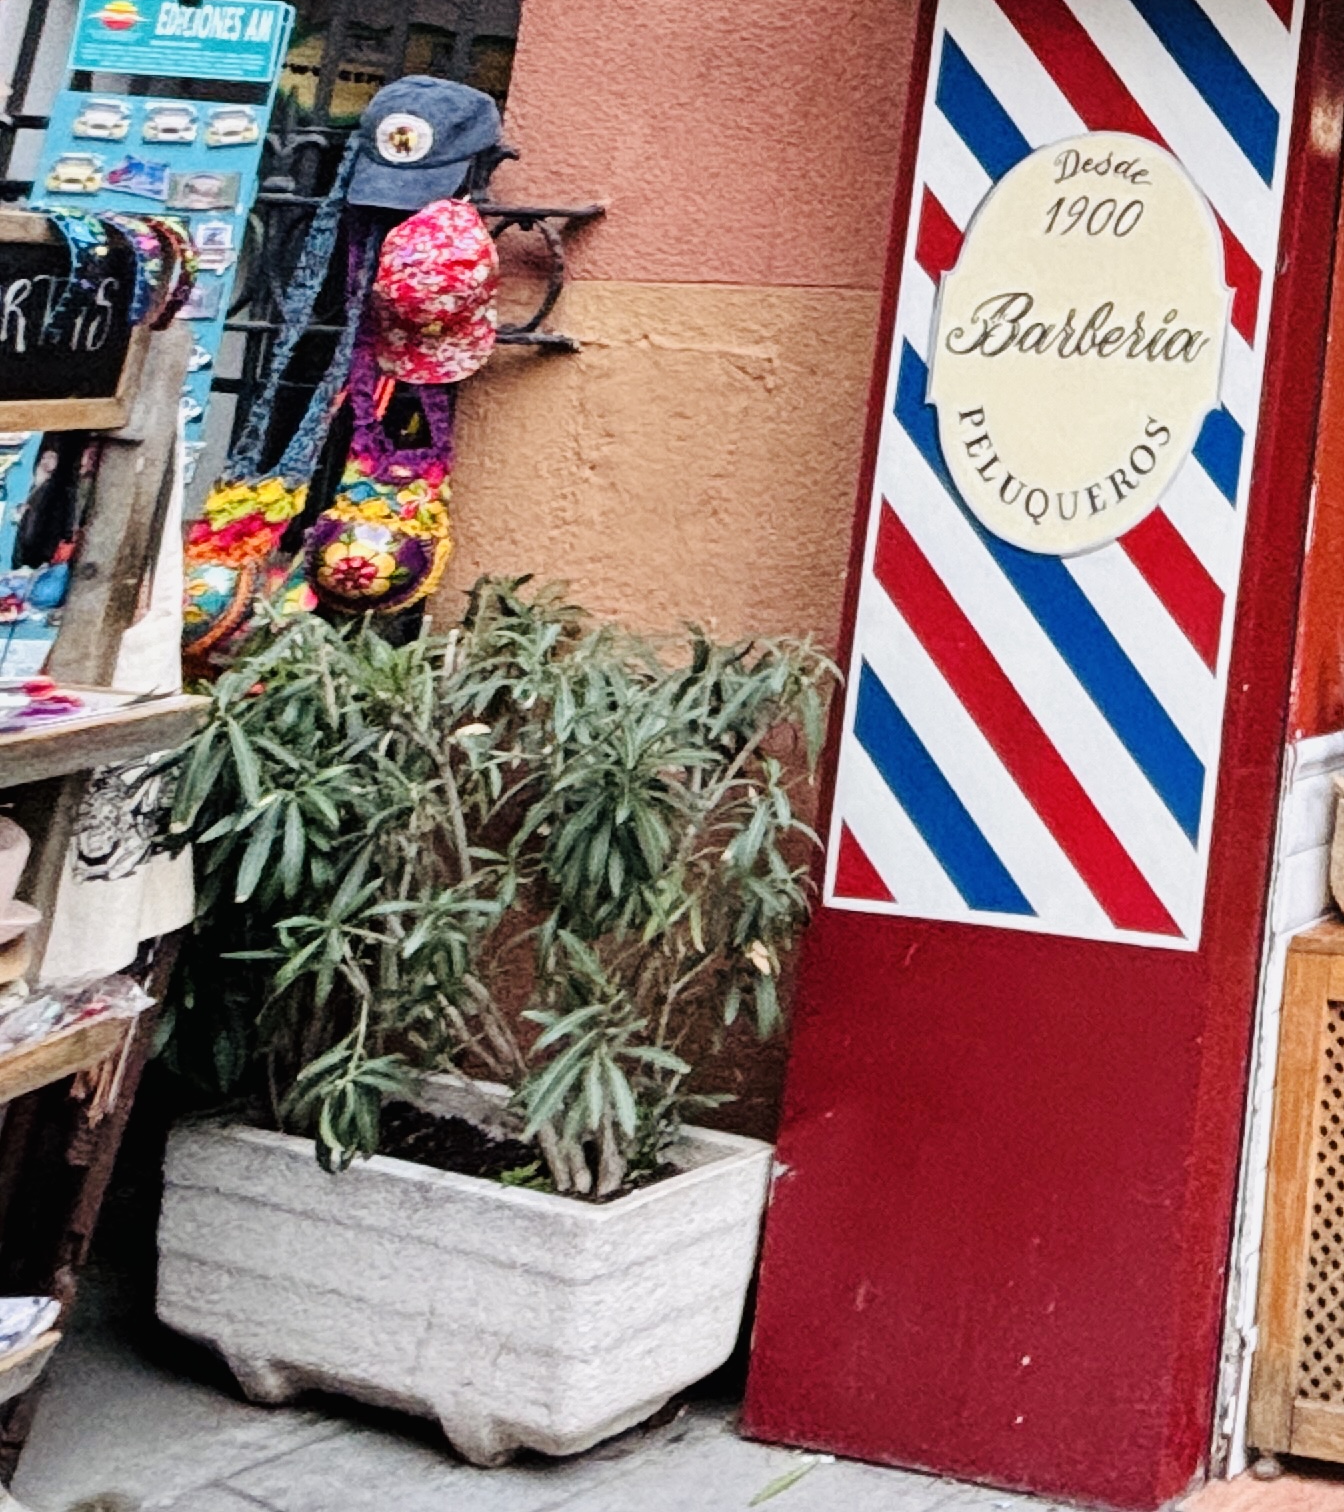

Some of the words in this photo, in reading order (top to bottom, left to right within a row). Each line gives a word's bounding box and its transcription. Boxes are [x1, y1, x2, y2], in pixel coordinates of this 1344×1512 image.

[1054, 149, 1152, 186] Desde
[1045, 195, 1144, 238] 1900
[958, 405, 1171, 525] PELUQUEROS
